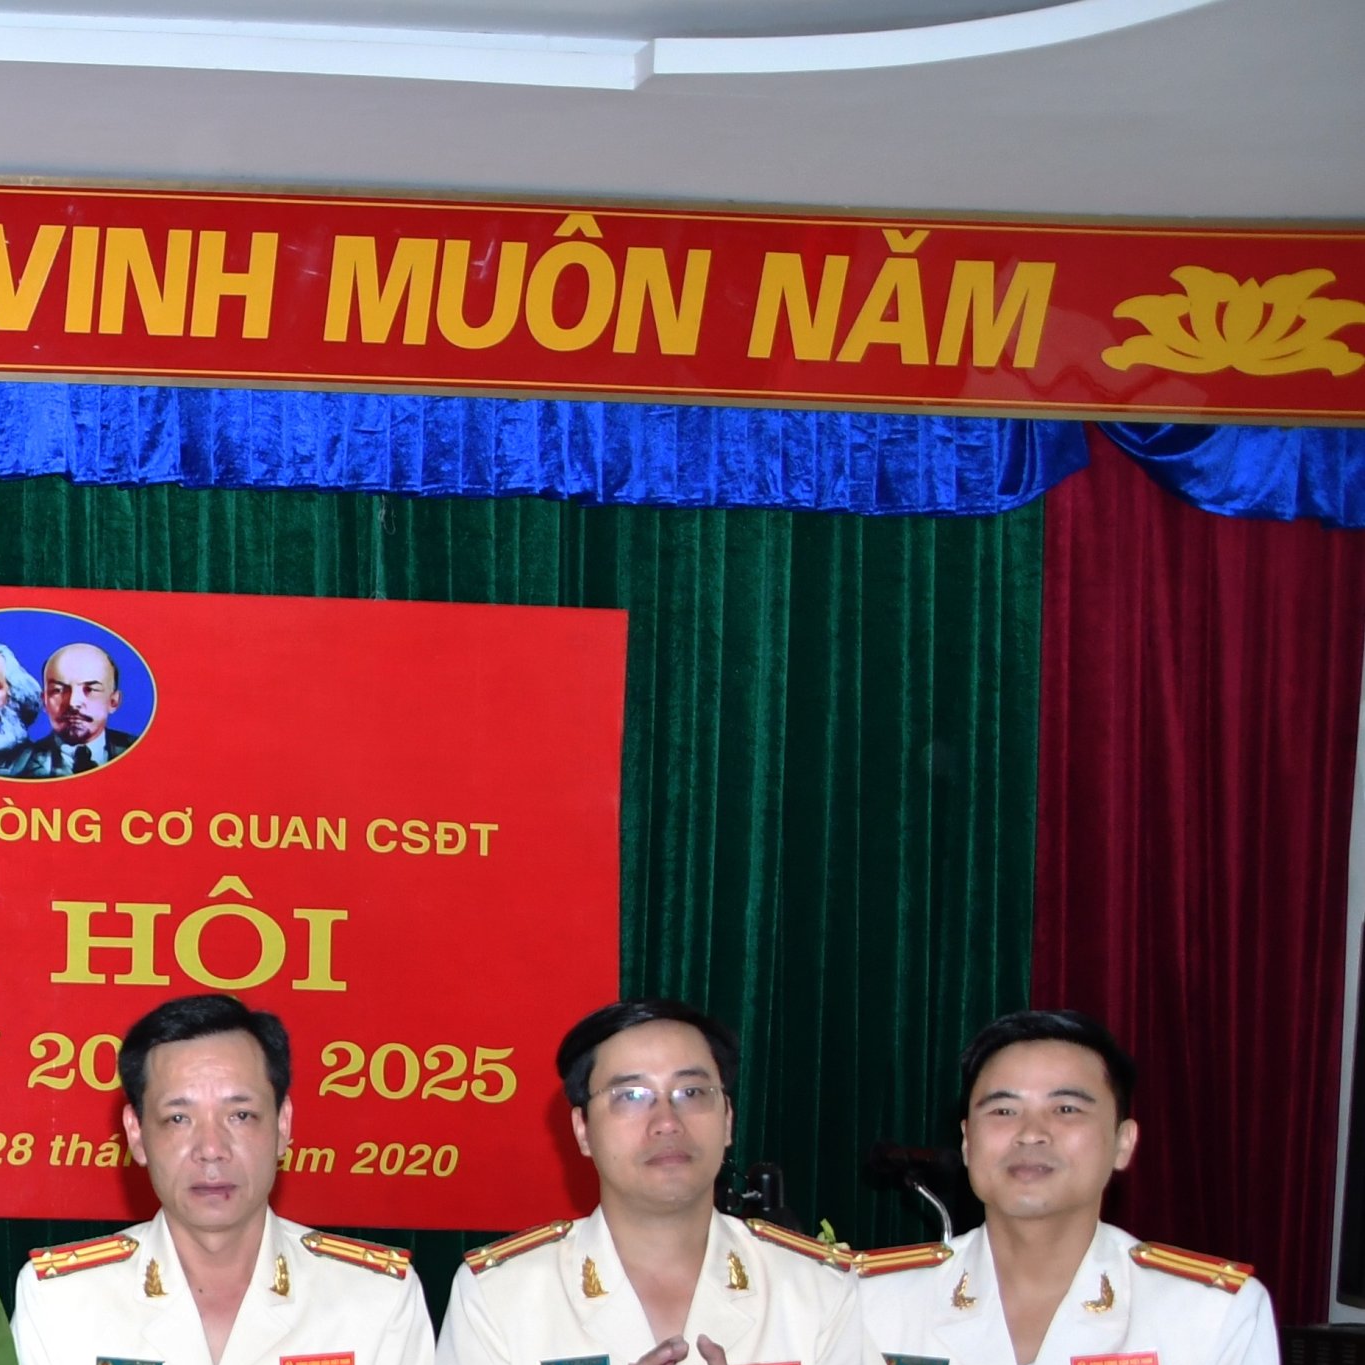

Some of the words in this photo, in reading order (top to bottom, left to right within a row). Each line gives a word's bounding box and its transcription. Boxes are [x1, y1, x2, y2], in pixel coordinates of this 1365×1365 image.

[323, 213, 711, 354] MUÔN
[747, 229, 1056, 368] NĂM
[120, 806, 193, 846] CƠ
[208, 812, 347, 851] QUAN
[366, 818, 499, 857] CSĐT
[27, 1032, 122, 1091] 20
[318, 1040, 518, 1103] 2025
[349, 1141, 460, 1178] 2020
